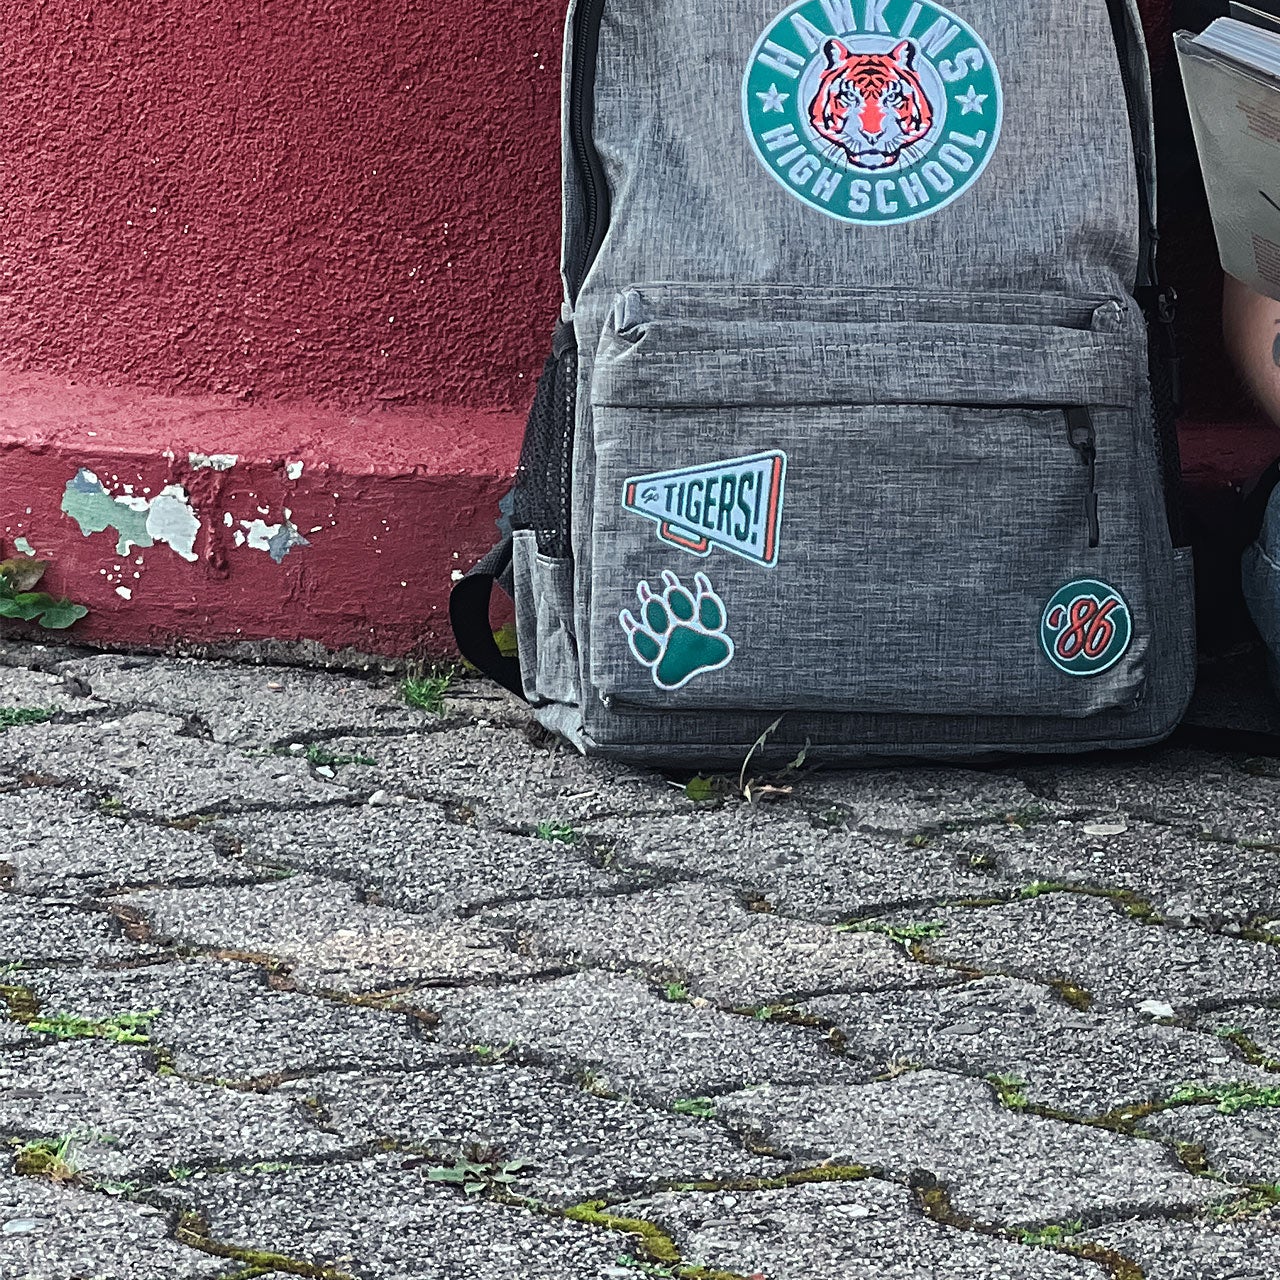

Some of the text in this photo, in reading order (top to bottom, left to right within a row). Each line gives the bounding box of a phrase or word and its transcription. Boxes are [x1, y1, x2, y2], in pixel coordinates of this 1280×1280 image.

[761, 123, 987, 214] HIGH SCHOOL
[664, 471, 763, 545] TIGERS!
